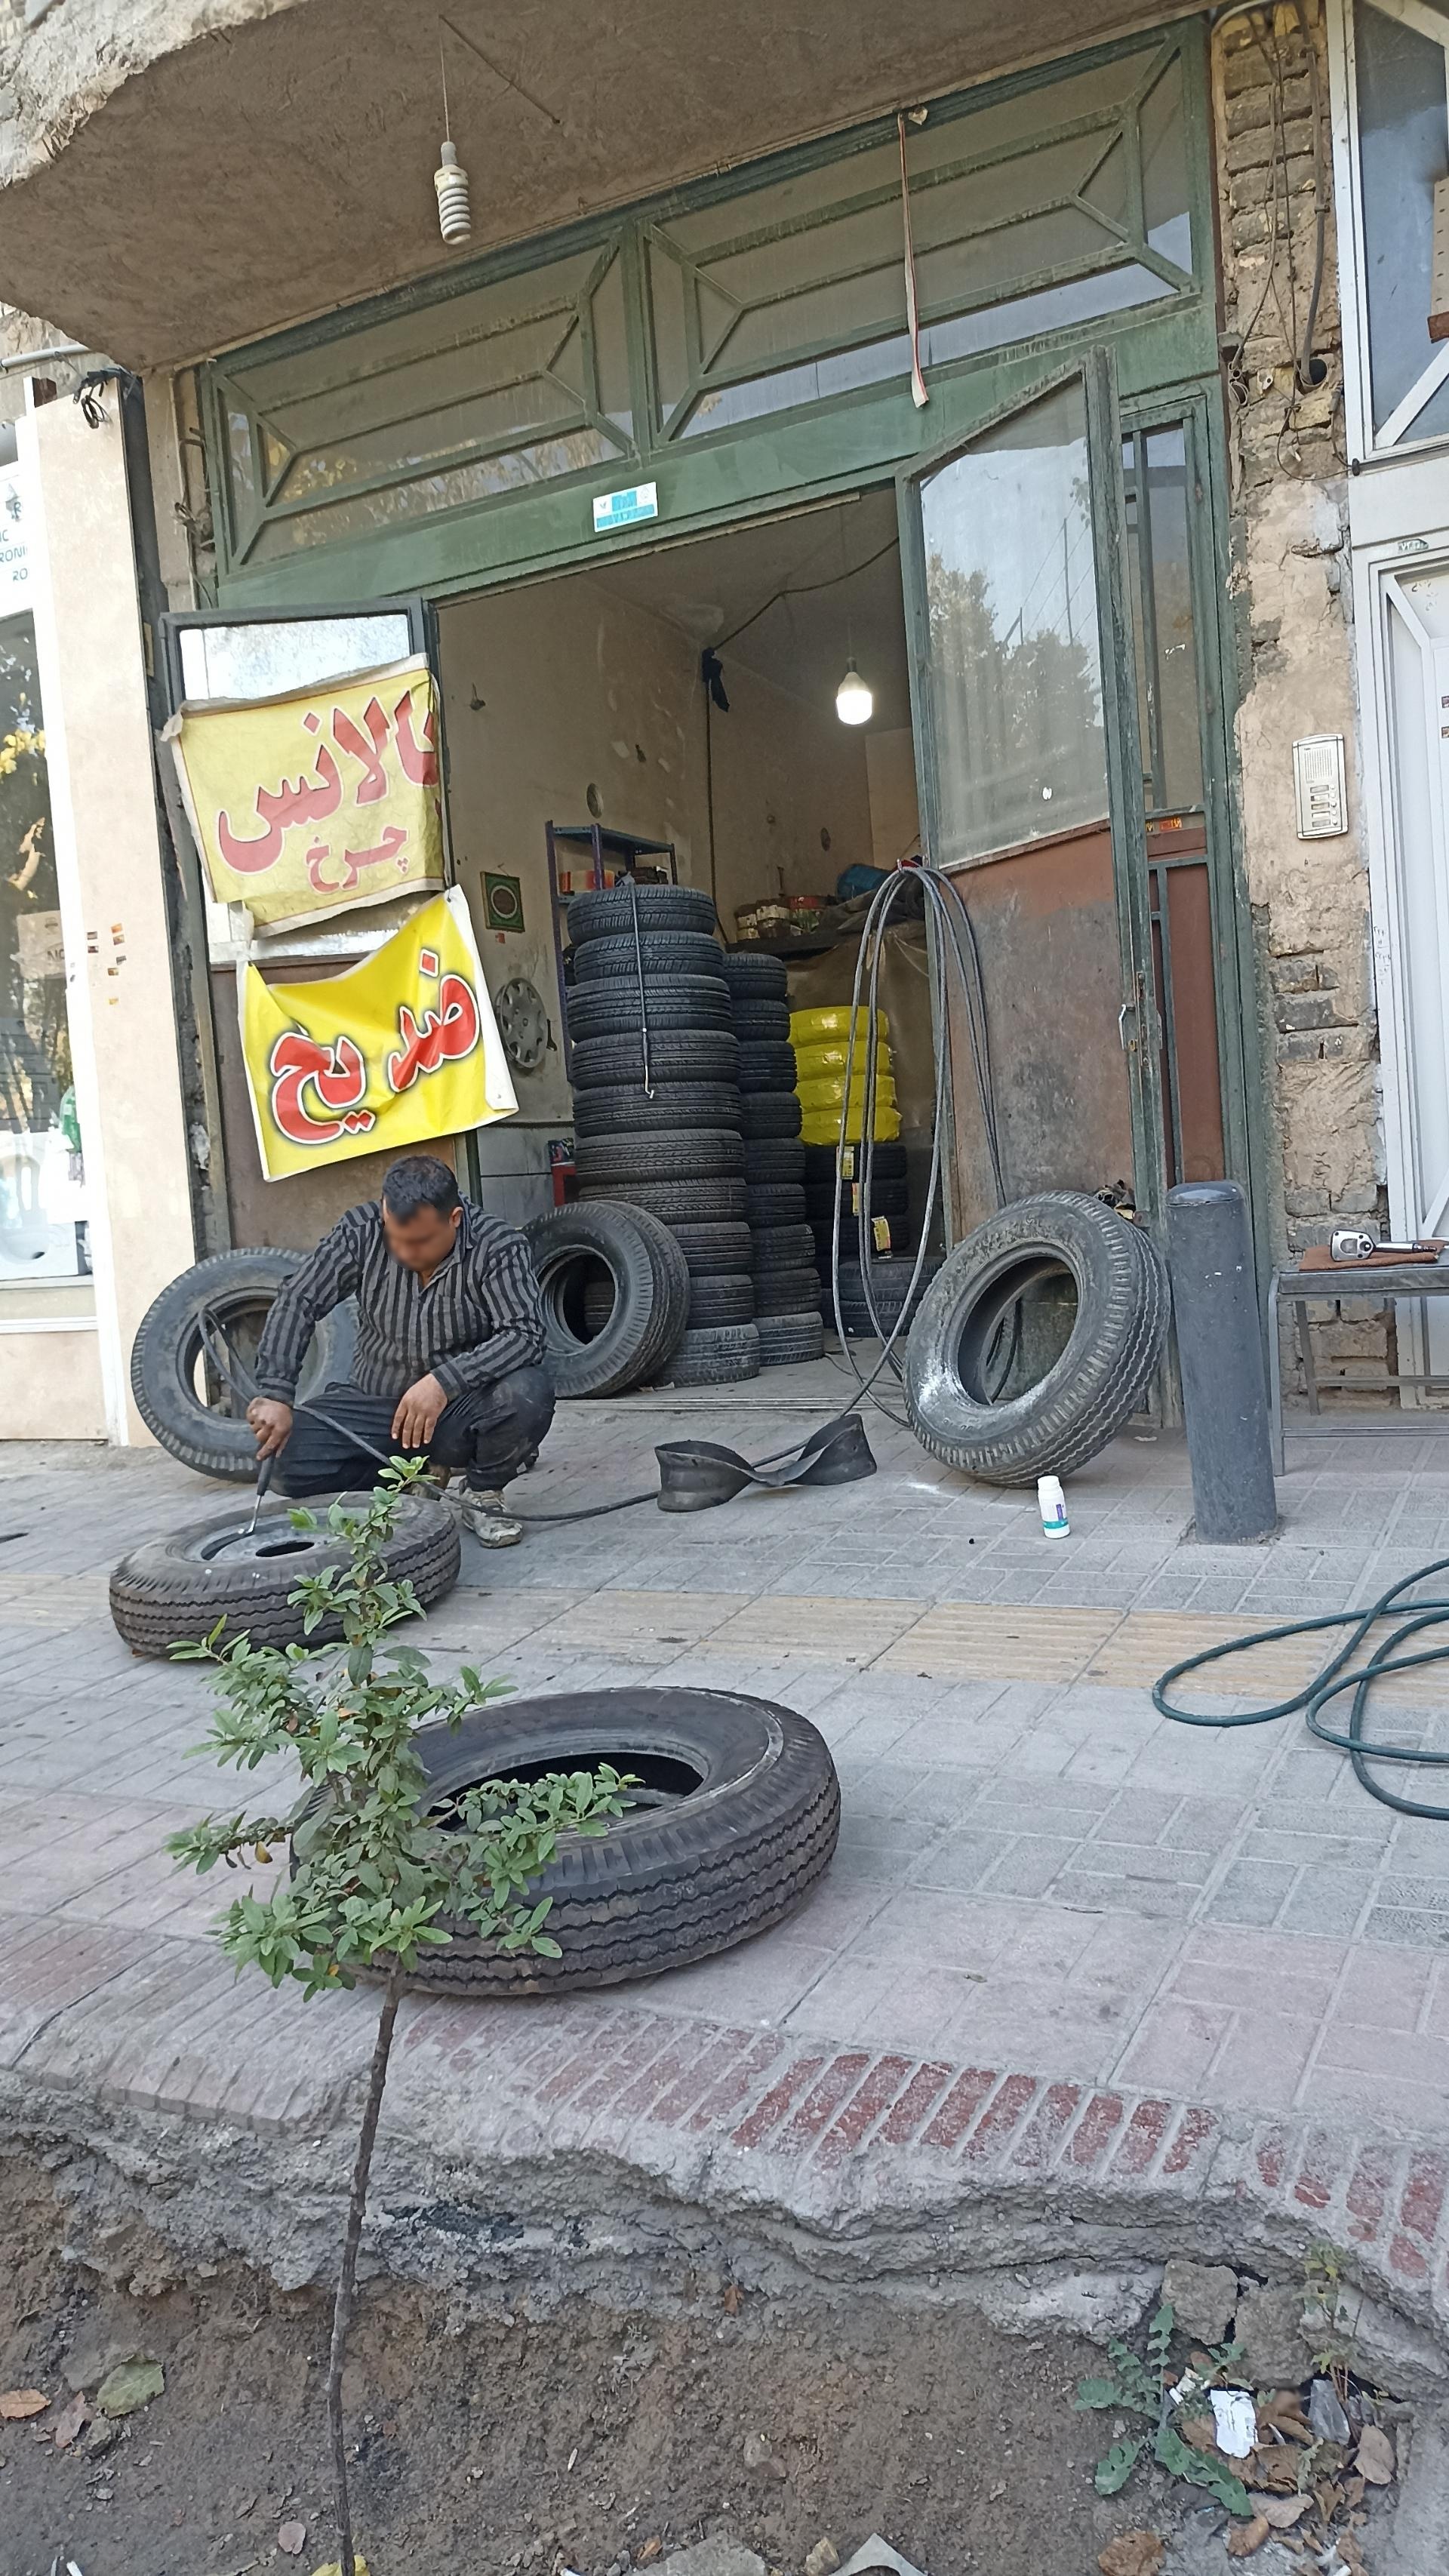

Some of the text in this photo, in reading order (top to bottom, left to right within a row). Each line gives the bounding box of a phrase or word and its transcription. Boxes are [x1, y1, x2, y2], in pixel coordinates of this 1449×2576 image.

[217, 688, 441, 874] بالانس
[305, 825, 408, 894] چرخ
[387, 948, 479, 1093] ضد
